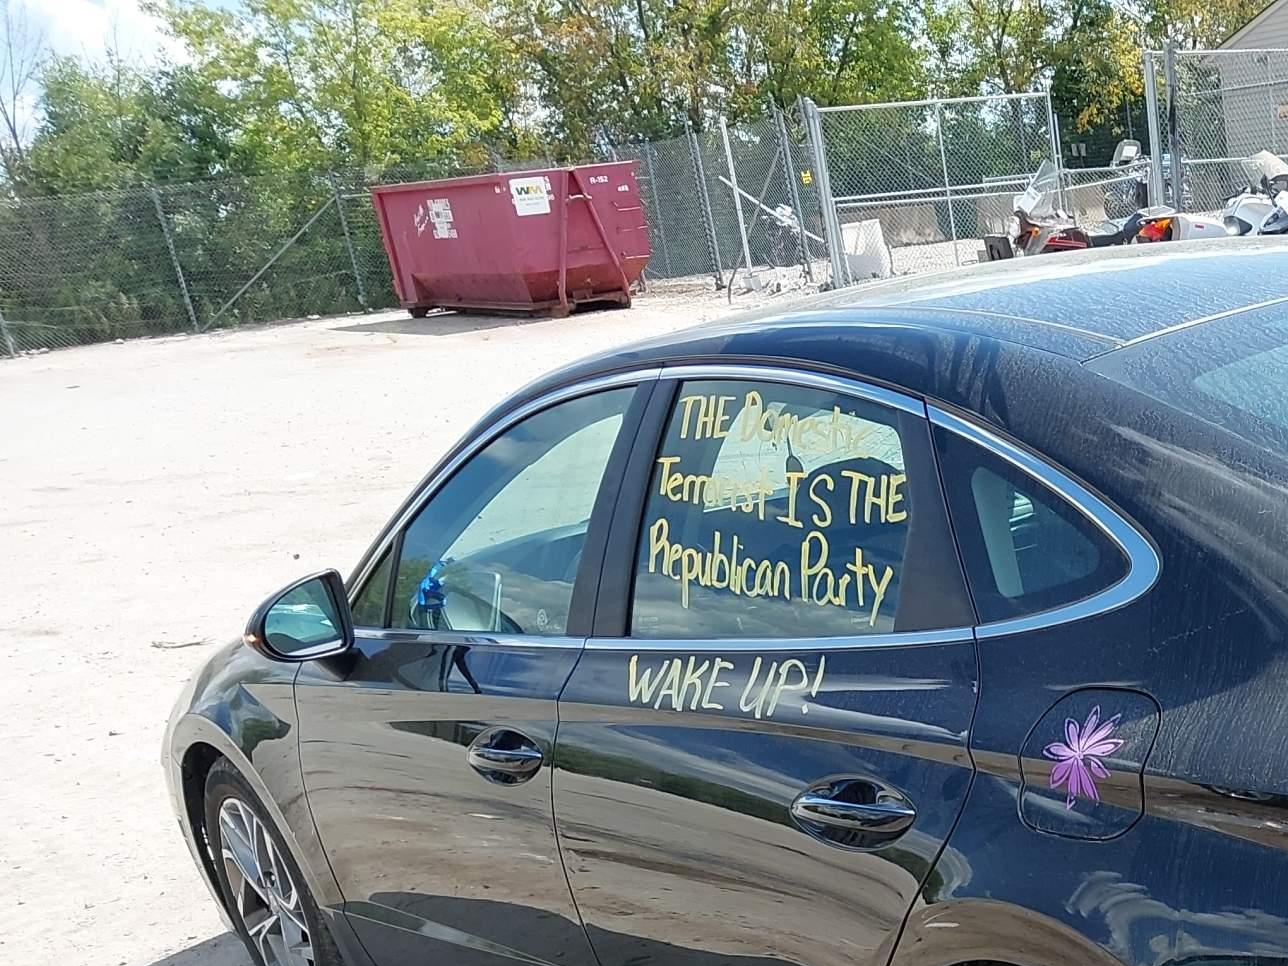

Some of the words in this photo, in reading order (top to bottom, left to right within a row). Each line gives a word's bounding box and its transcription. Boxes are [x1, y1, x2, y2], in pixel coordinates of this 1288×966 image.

[679, 395, 736, 440] THE
[739, 391, 869, 456] Domestic
[657, 457, 773, 520] Terrorist
[776, 472, 834, 528] IS
[841, 470, 908, 525] THE
[649, 519, 791, 608] Republican
[801, 531, 893, 627] Party
[629, 655, 734, 712] WAKE
[739, 655, 826, 719] UP!
